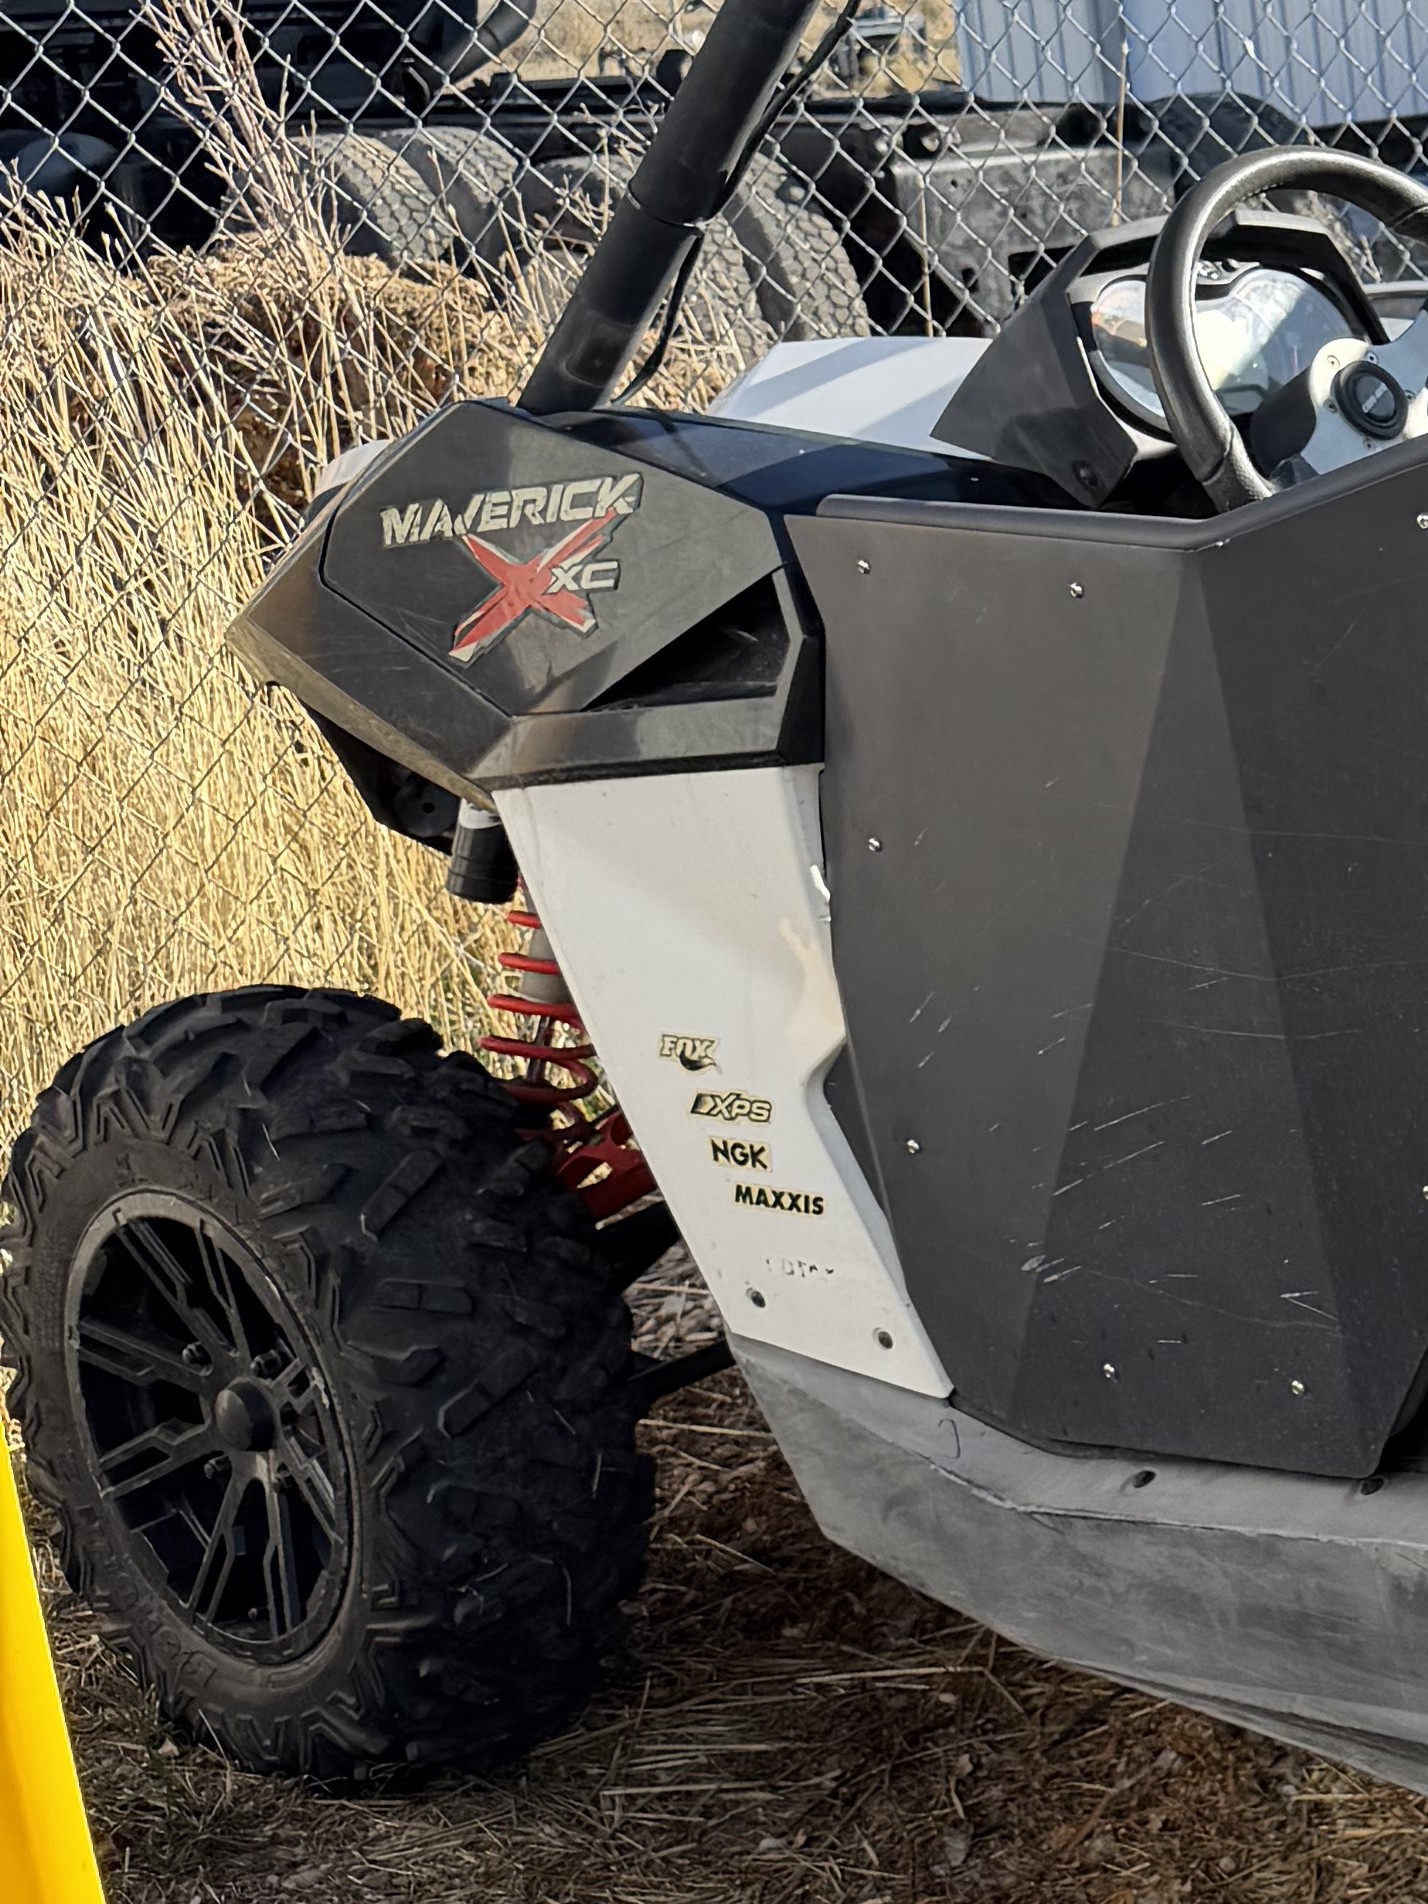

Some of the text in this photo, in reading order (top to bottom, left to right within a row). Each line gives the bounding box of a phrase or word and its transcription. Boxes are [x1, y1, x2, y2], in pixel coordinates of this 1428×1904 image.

[381, 473, 641, 547] MAVERICK
[660, 1034, 717, 1063] FOX
[710, 1139, 768, 1170] NGK
[734, 1184, 824, 1215] MAXXIS
